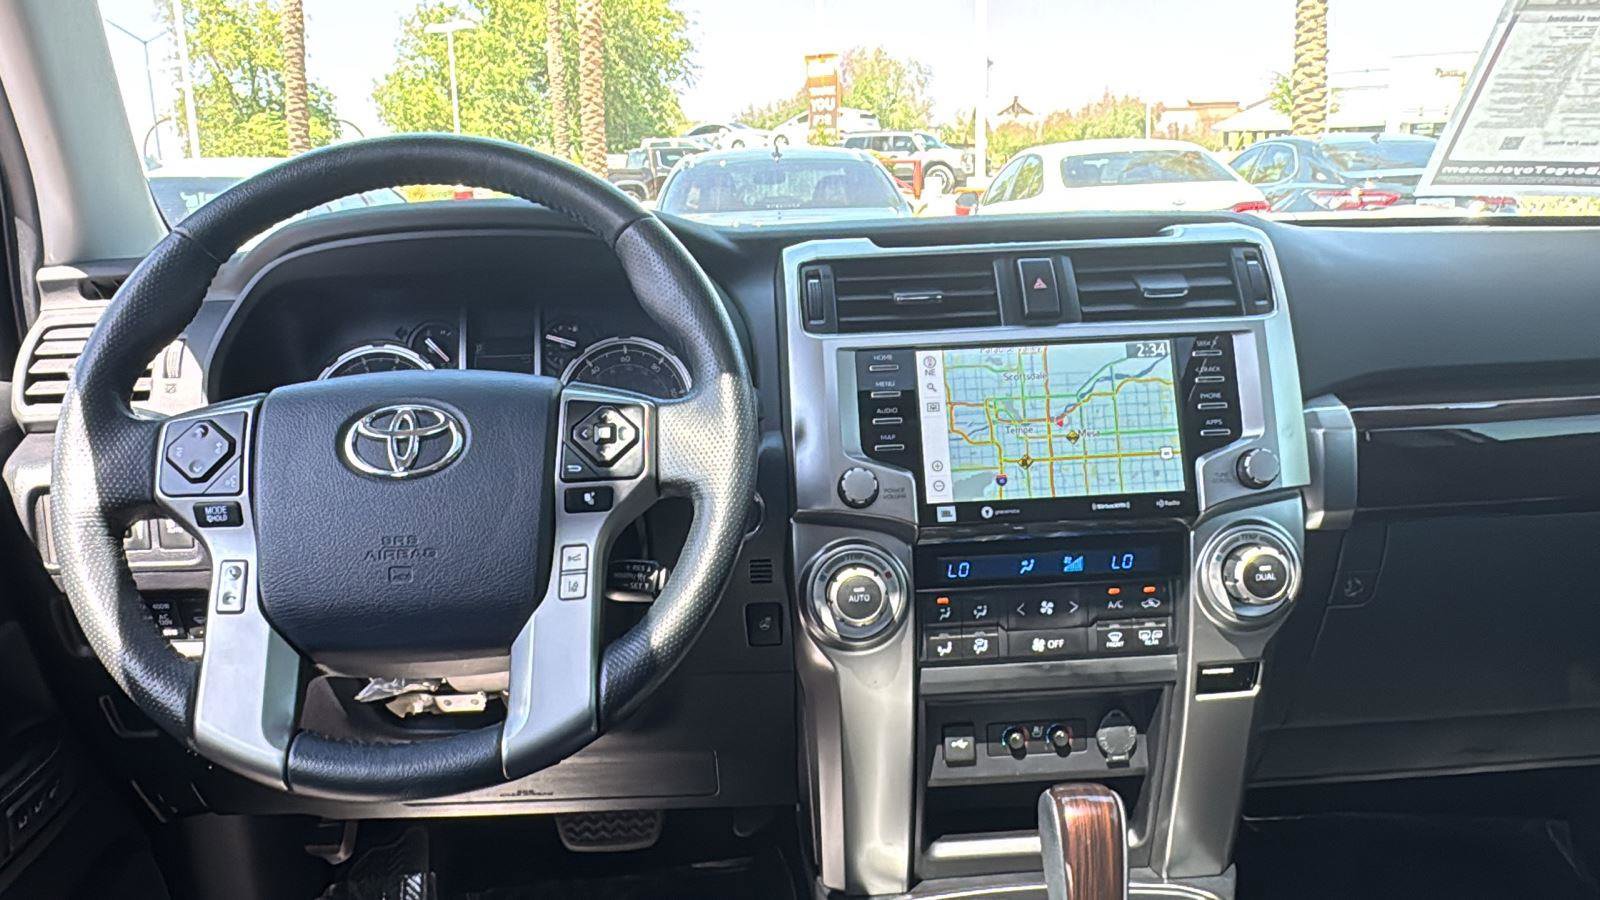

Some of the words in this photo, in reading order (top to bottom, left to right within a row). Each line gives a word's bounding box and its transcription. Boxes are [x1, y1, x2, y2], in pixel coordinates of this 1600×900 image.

[1136, 342, 1166, 357] 2:34
[873, 353, 893, 361] HOME
[875, 380, 896, 388] MENU
[876, 406, 899, 415] AUDIO
[1005, 425, 1034, 436] Tempe
[1078, 428, 1101, 438] Mesa
[880, 433, 897, 441] MAP
[204, 505, 229, 515] MODE
[1110, 554, 1134, 570] LO
[948, 562, 971, 579] LO
[1255, 572, 1277, 582] DUAL
[848, 593, 871, 603] AUTO
[1107, 600, 1124, 609] A/C
[1047, 637, 1065, 650] OFF
